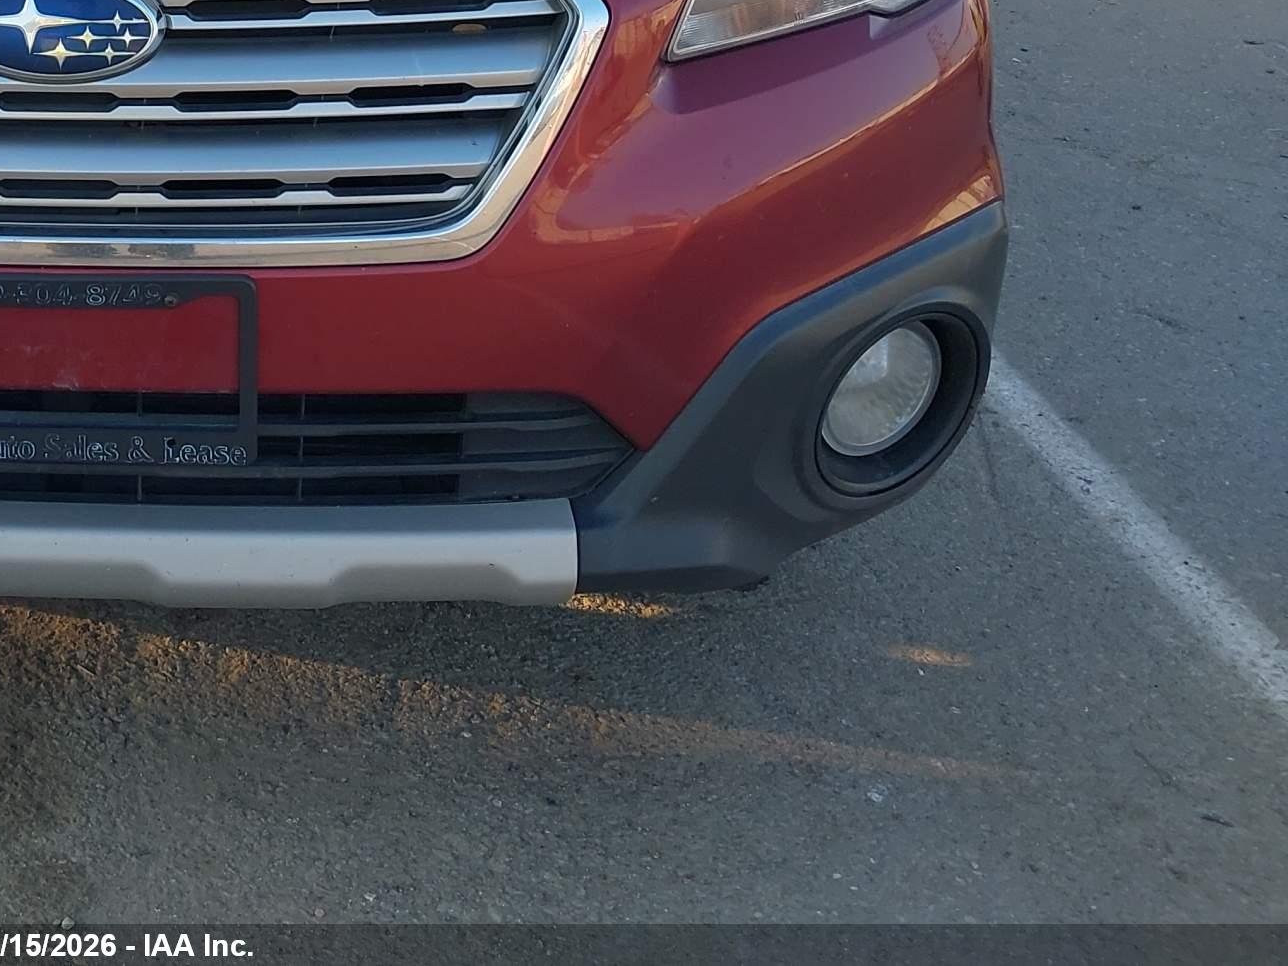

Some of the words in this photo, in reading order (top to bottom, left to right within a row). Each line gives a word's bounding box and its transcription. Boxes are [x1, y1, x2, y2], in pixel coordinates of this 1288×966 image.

[42, 433, 119, 461] Sales
[125, 435, 155, 464] &
[159, 436, 248, 466] Lease
